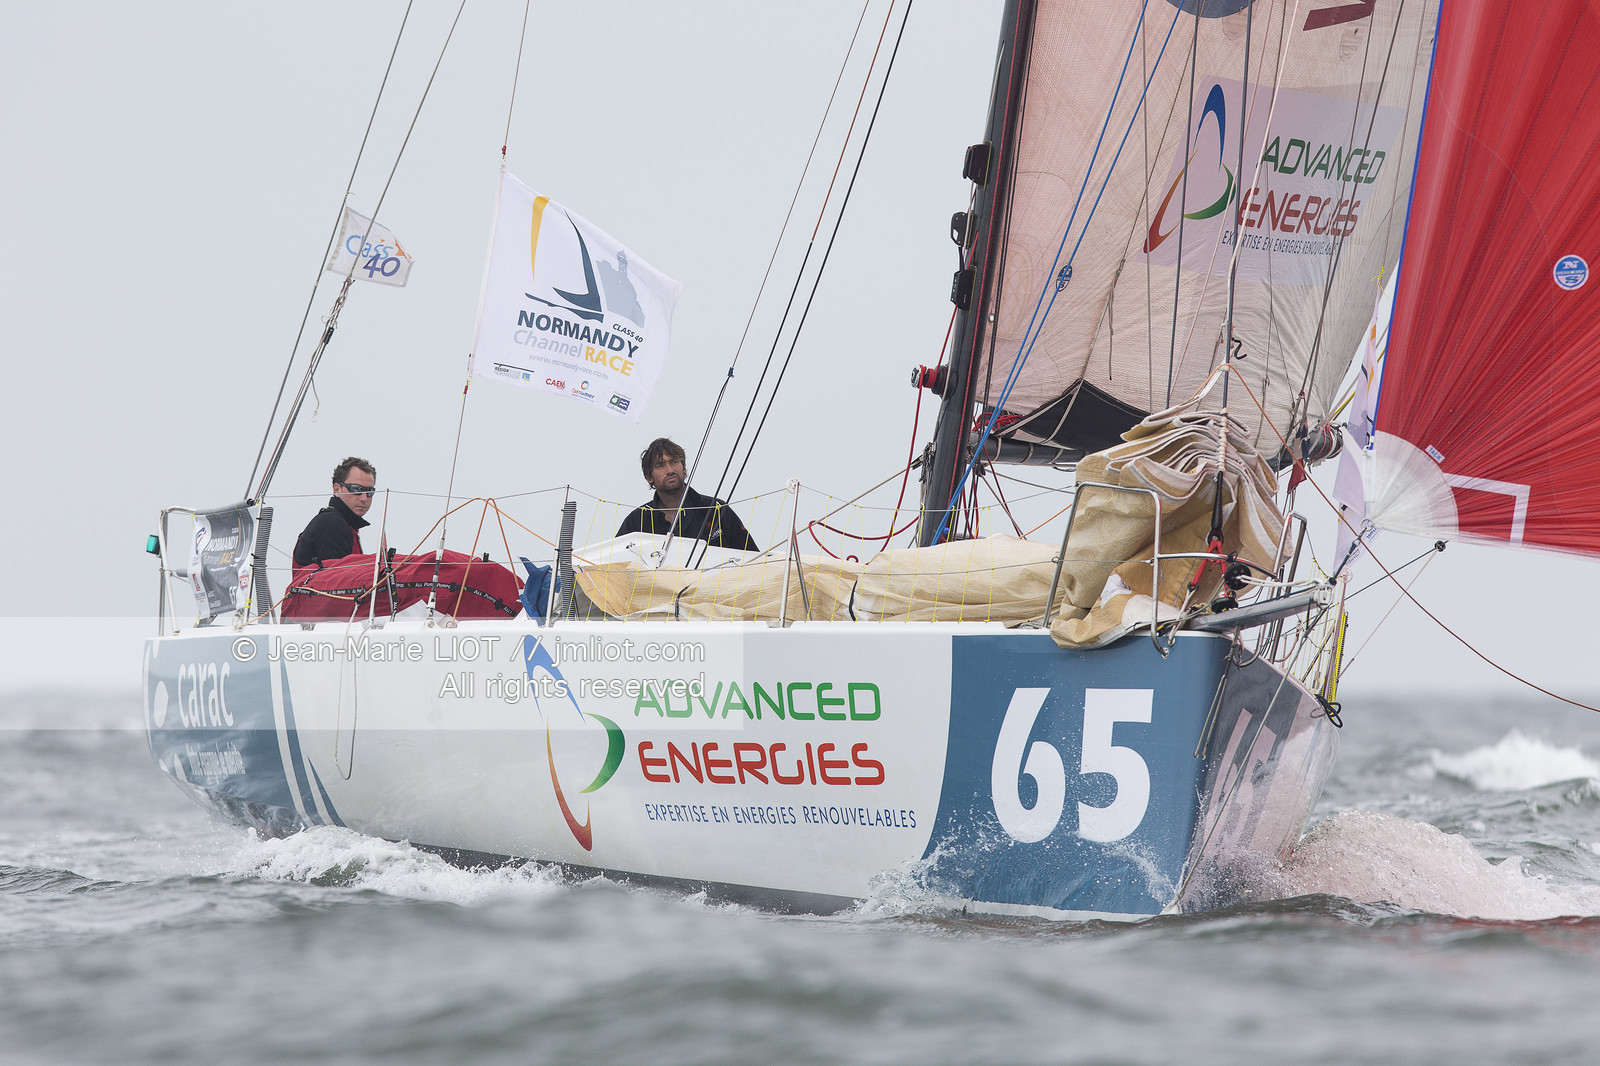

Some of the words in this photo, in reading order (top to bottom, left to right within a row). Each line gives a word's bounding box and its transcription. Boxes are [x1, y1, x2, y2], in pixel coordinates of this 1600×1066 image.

[1256, 135, 1386, 184] ADVANCED
[1238, 187, 1361, 237] ENERGIES
[346, 234, 394, 260] Class
[363, 253, 401, 278] 40
[513, 329, 583, 358] Channel
[584, 346, 634, 377] RACE
[517, 310, 639, 358] NORMANDY
[612, 323, 636, 338] CLASS
[634, 335, 644, 343] 40
[529, 353, 609, 380] www.normandy-race.com
[178, 661, 234, 728] carac
[633, 681, 881, 721] ADVANCED
[637, 741, 886, 786] ENERGIES
[991, 687, 1155, 843] 65
[645, 803, 709, 823] EXPERTISE
[711, 806, 730, 823] EN
[733, 806, 797, 825] ENERGIES
[802, 805, 917, 828] RENOUVELABLES
